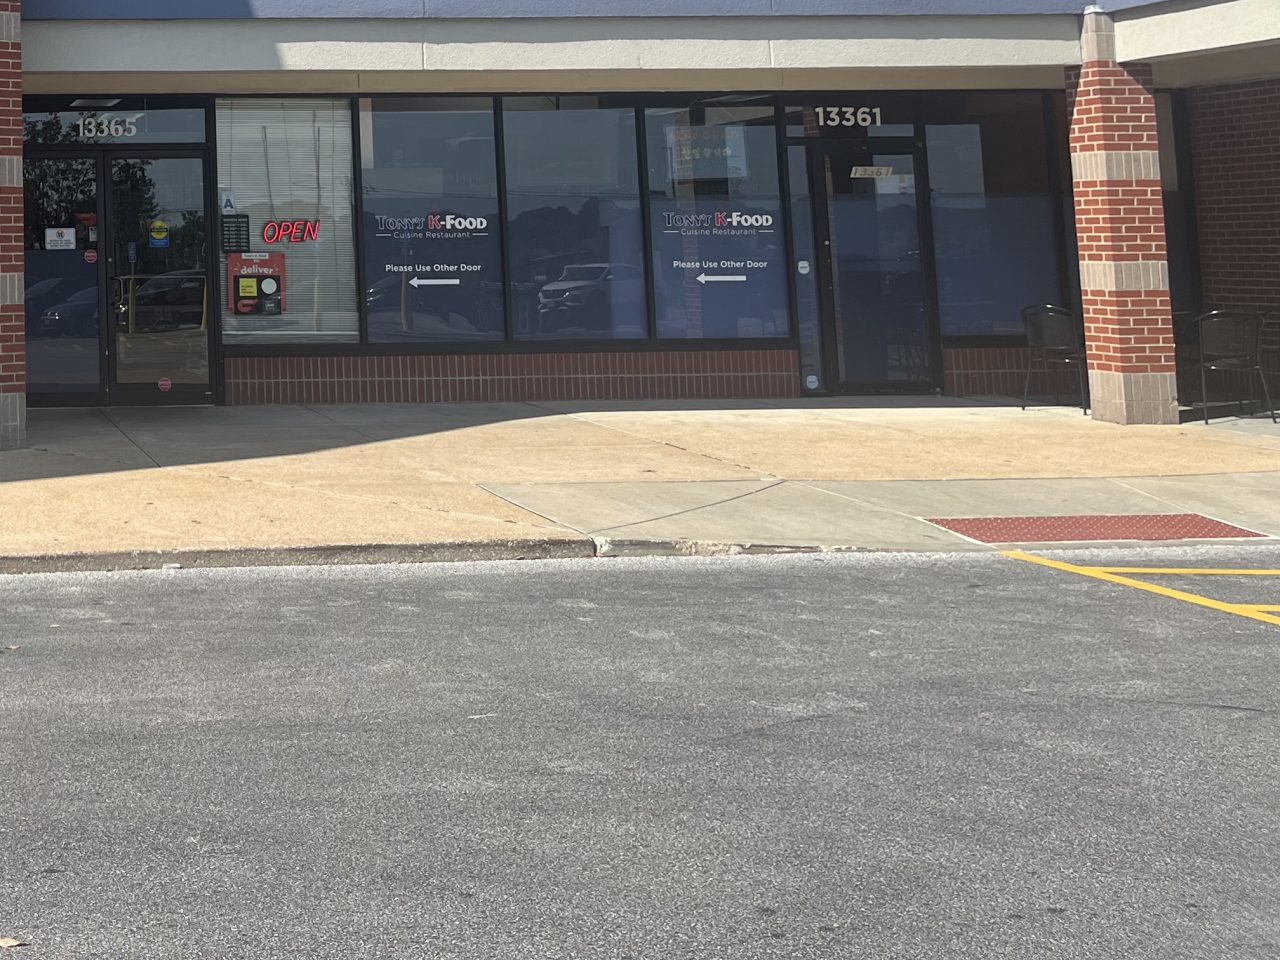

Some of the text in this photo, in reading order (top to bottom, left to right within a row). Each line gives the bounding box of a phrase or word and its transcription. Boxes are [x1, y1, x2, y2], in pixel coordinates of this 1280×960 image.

[814, 106, 881, 127] 13361
[75, 117, 137, 138] 13365
[223, 198, 234, 209] A
[263, 219, 321, 244] OPEN
[393, 231, 471, 239] Cuisine Restaurant
[680, 228, 758, 236] Cuisine Restaurant
[240, 264, 274, 275] deliver
[385, 263, 482, 272] Please Use Other Door
[673, 260, 768, 268] Please Use Other Door
